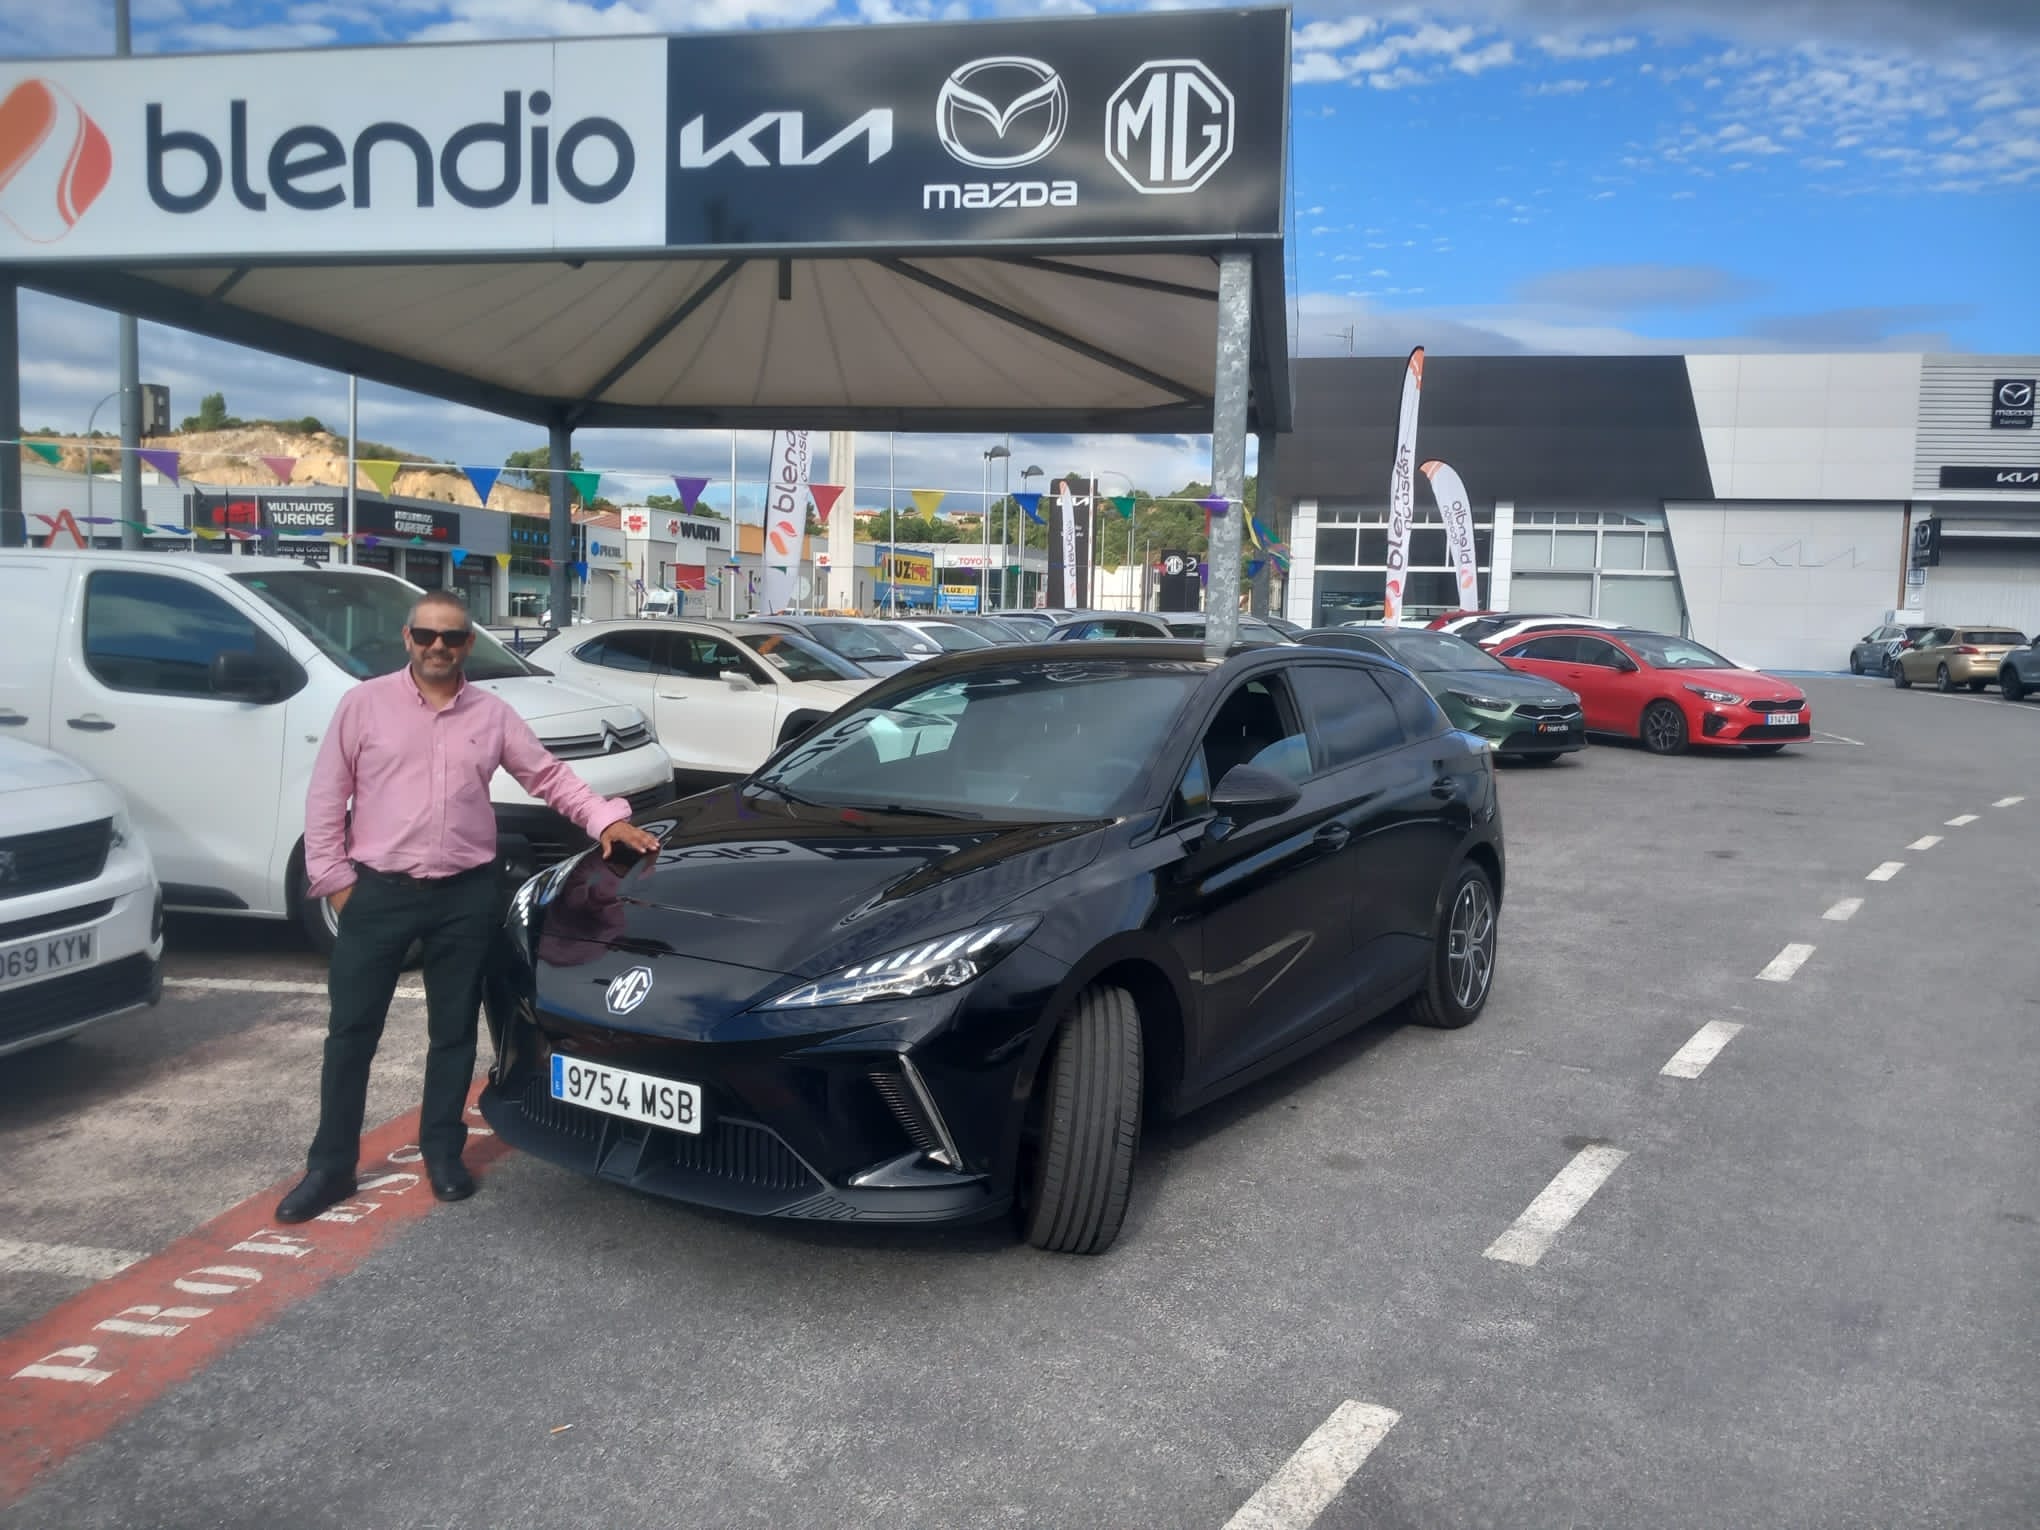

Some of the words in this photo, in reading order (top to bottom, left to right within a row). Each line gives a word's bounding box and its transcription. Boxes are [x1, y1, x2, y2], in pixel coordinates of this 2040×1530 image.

[680, 108, 893, 168] KIA
[1113, 68, 1226, 184] MG
[146, 90, 636, 214] blendio
[923, 180, 1077, 209] mazda
[1996, 472, 2039, 482] KIA
[48, 933, 91, 968] KYW
[607, 968, 650, 1012] MG
[568, 1066, 631, 1111] 9754
[641, 1081, 693, 1125] MSB
